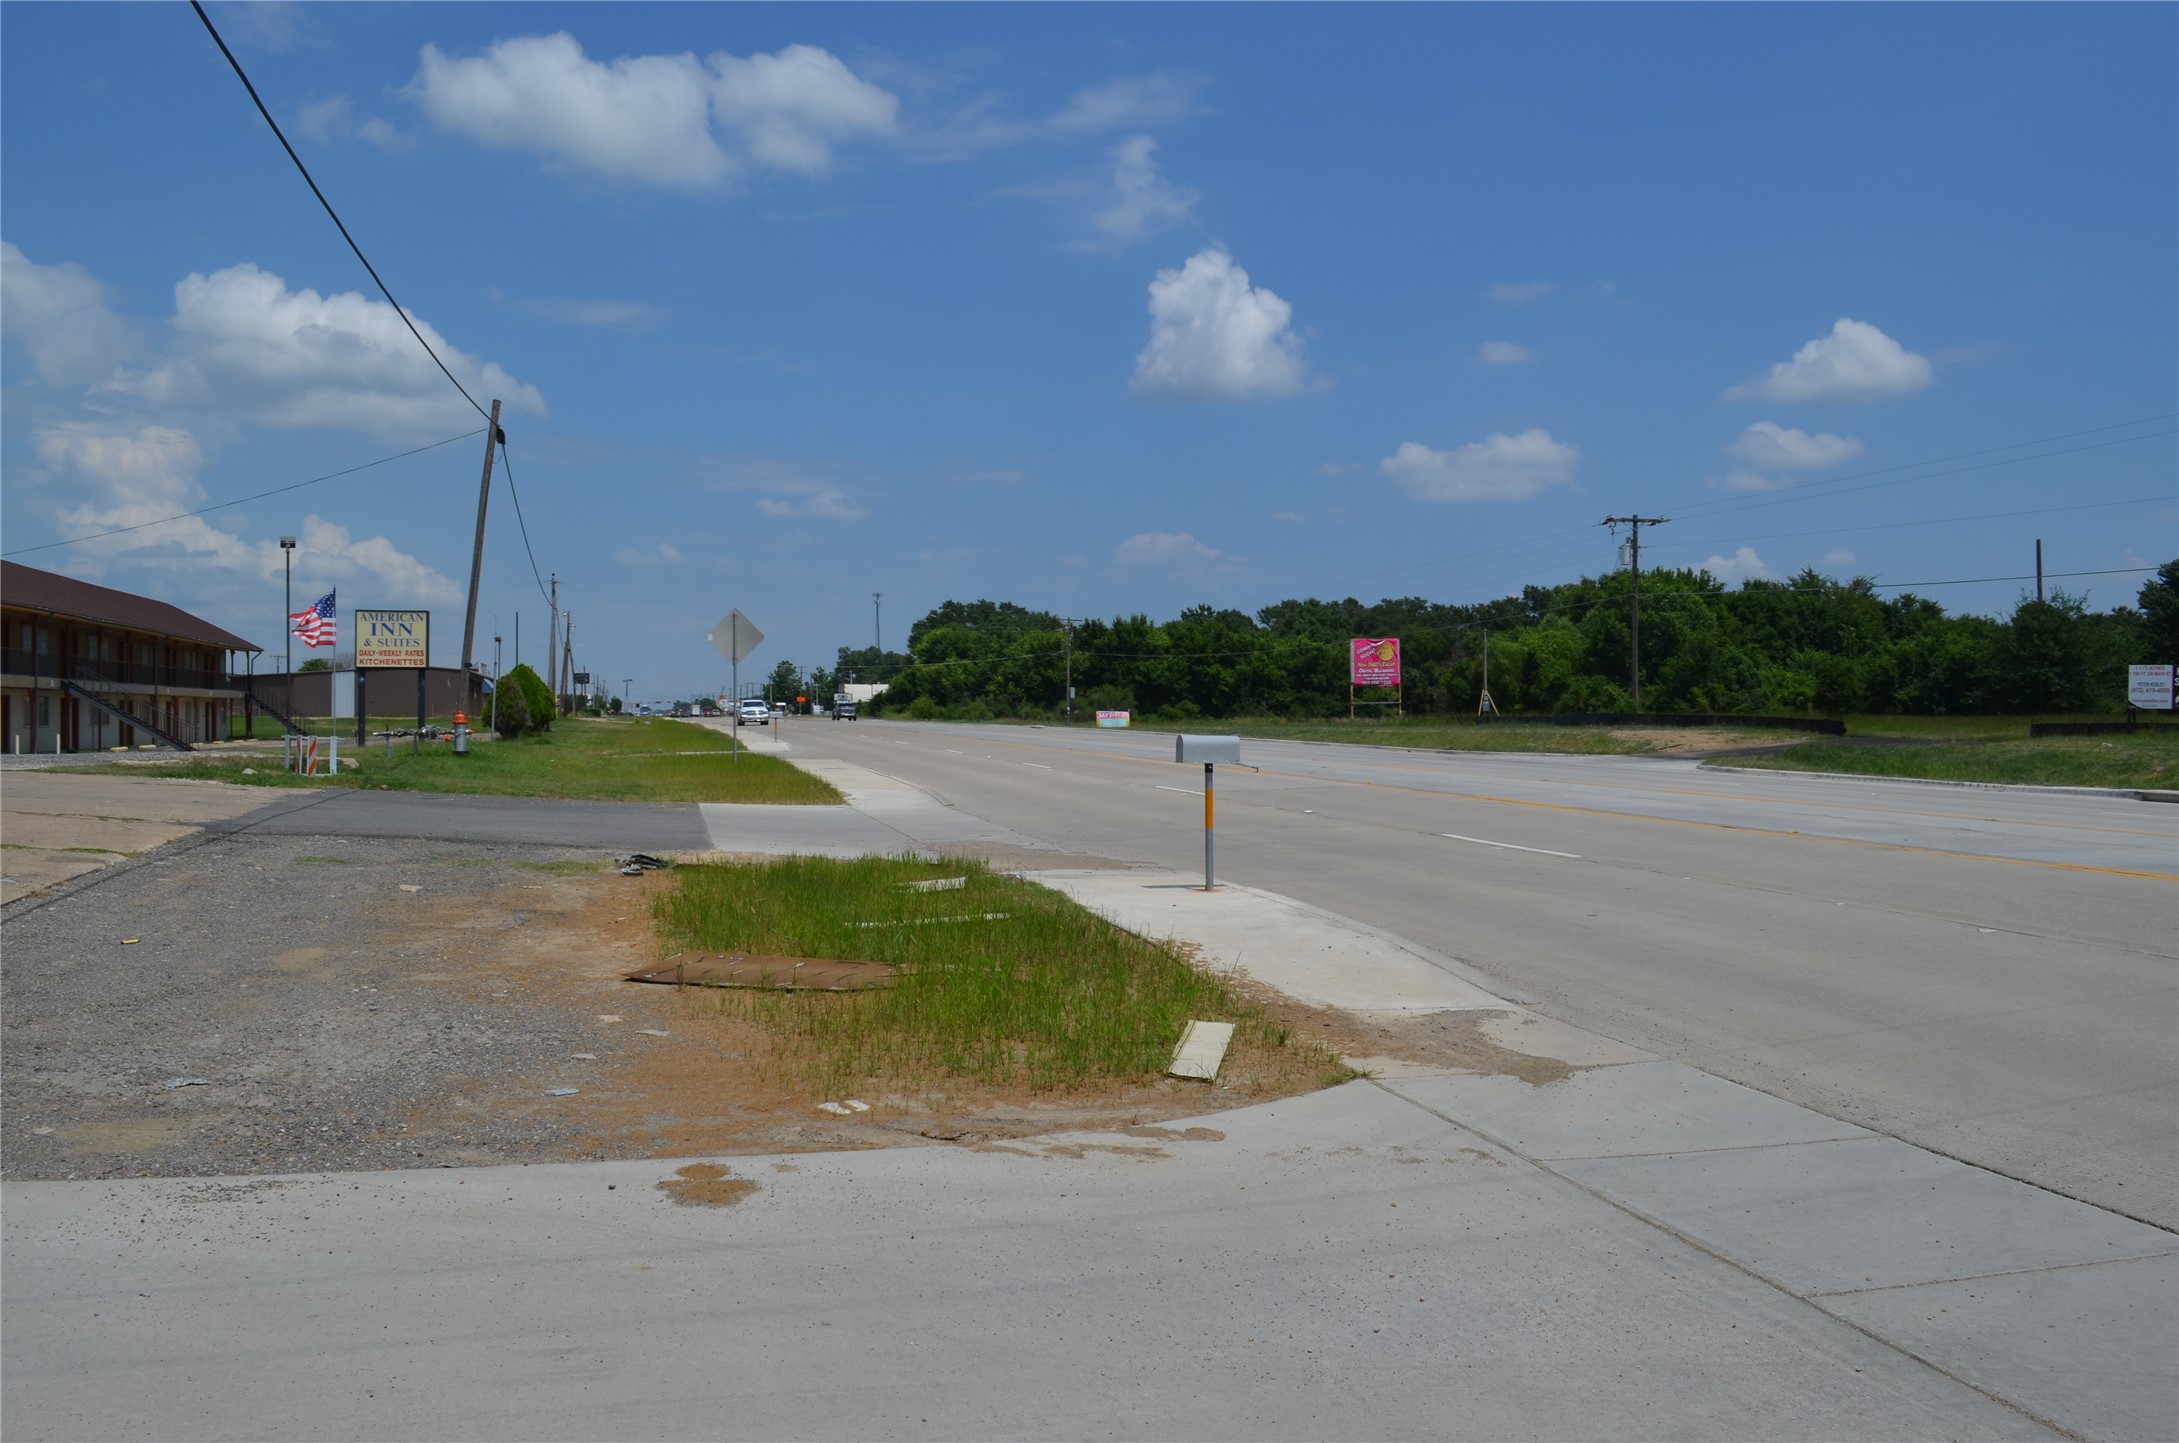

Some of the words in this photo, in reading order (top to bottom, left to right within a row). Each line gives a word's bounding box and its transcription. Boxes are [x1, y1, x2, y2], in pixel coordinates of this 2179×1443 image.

[360, 612, 424, 622] AMERICAN
[370, 623, 414, 636] INN
[363, 638, 372, 647] &
[377, 638, 420, 647] SUITES
[359, 649, 402, 657] DAILY-WEEKLY
[405, 649, 425, 657] RATES
[359, 658, 425, 666] KITCHENETTES
